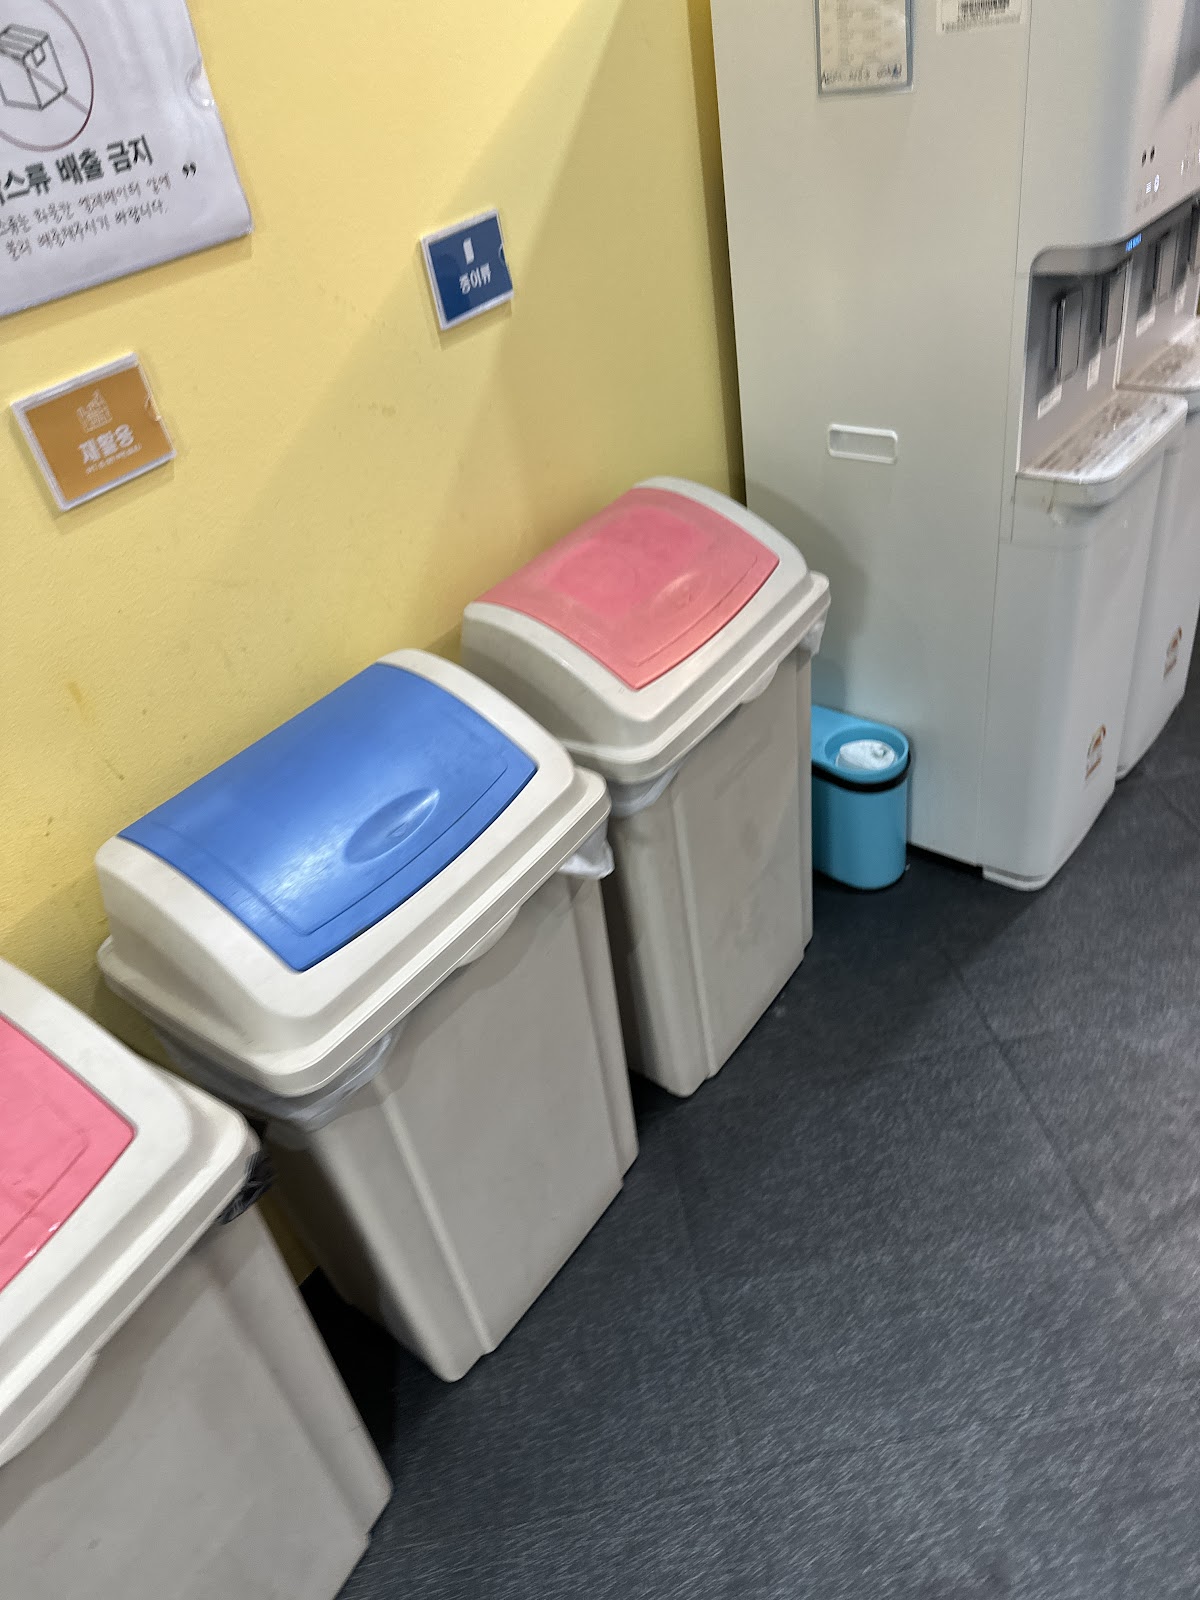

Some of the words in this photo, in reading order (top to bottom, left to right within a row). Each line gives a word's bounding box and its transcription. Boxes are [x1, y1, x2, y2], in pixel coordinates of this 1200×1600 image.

[0, 161, 51, 205] 스류
[56, 148, 104, 185] 배출
[106, 134, 153, 175] 금지
[459, 262, 491, 294] 종이류
